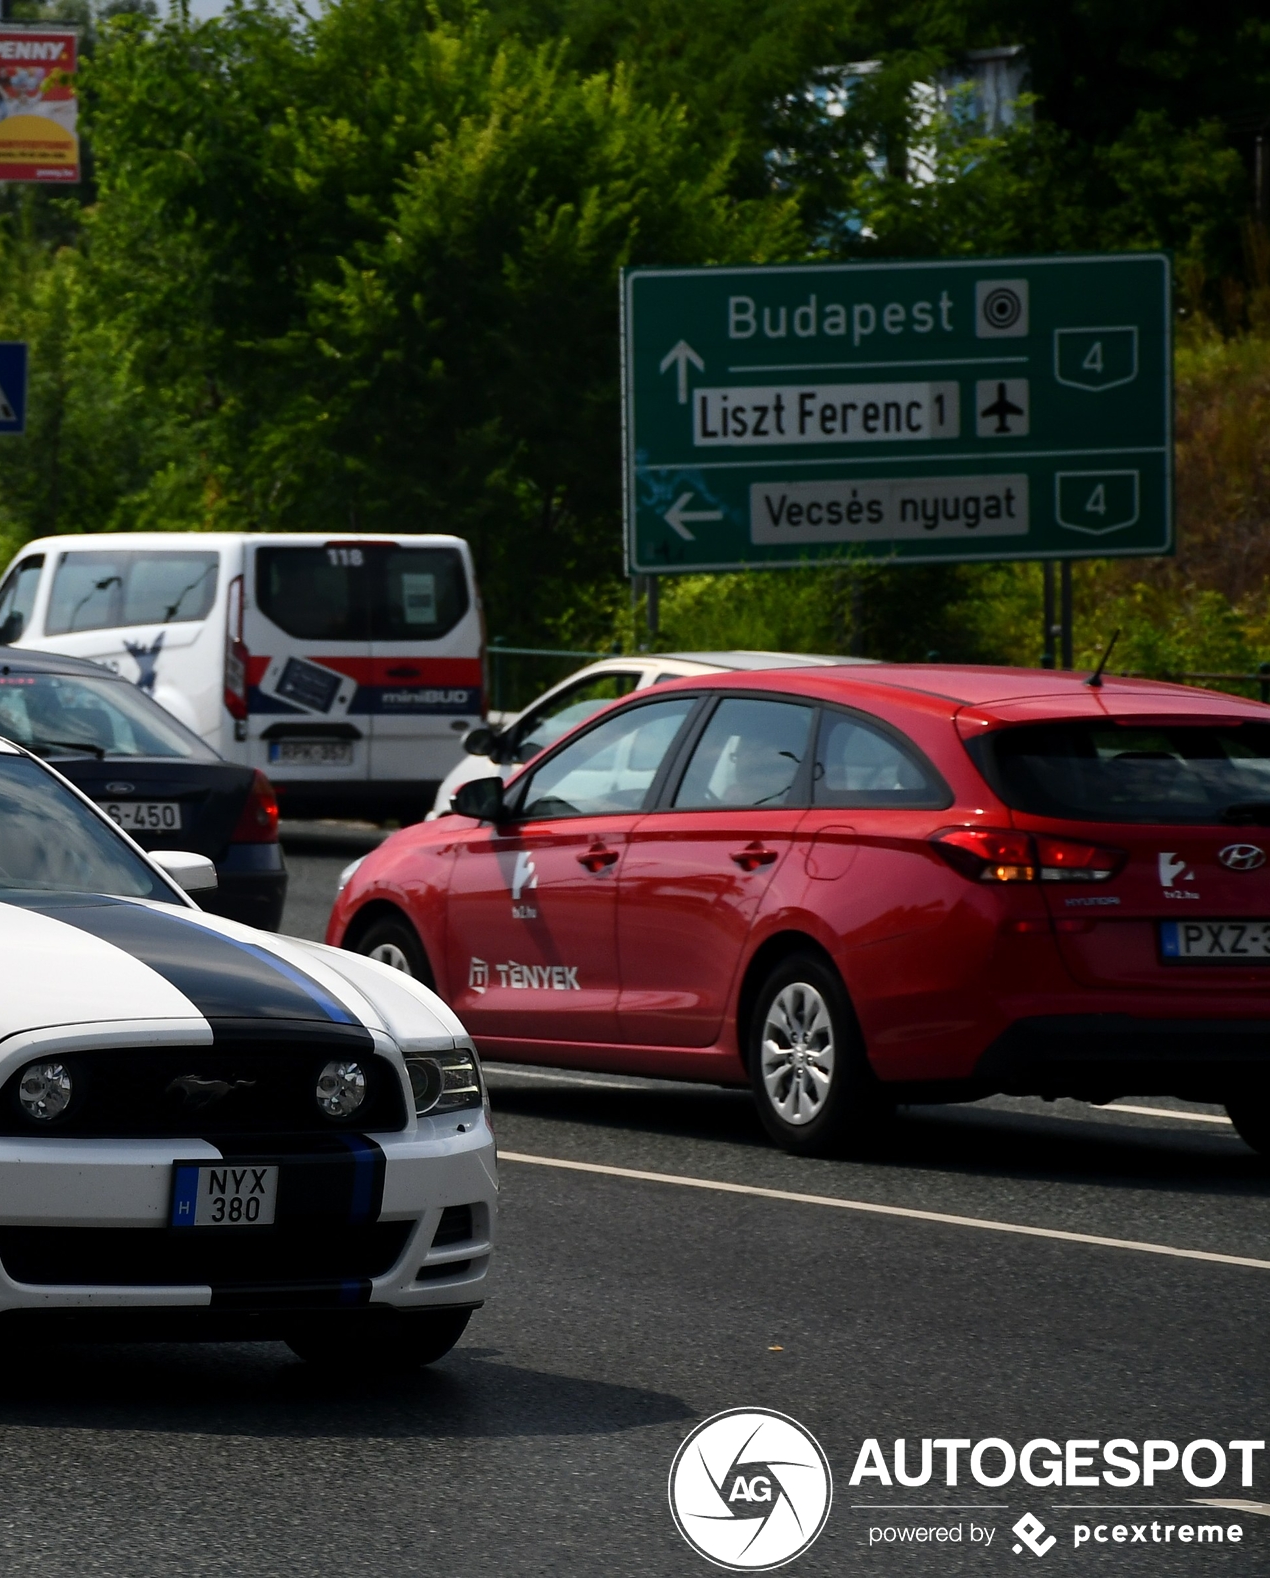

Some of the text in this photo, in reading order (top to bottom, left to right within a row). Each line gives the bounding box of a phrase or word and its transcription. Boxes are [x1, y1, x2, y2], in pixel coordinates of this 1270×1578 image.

[728, 291, 954, 346] Budapest
[1082, 342, 1105, 374] 4
[700, 393, 946, 438] Liszt Ferenc 1
[764, 487, 1017, 530] Vecsés nyugat
[1085, 484, 1106, 516] 4
[328, 549, 364, 567] 118
[209, 1169, 267, 1195] NYX
[179, 1201, 190, 1215] H
[212, 1197, 260, 1222] 380
